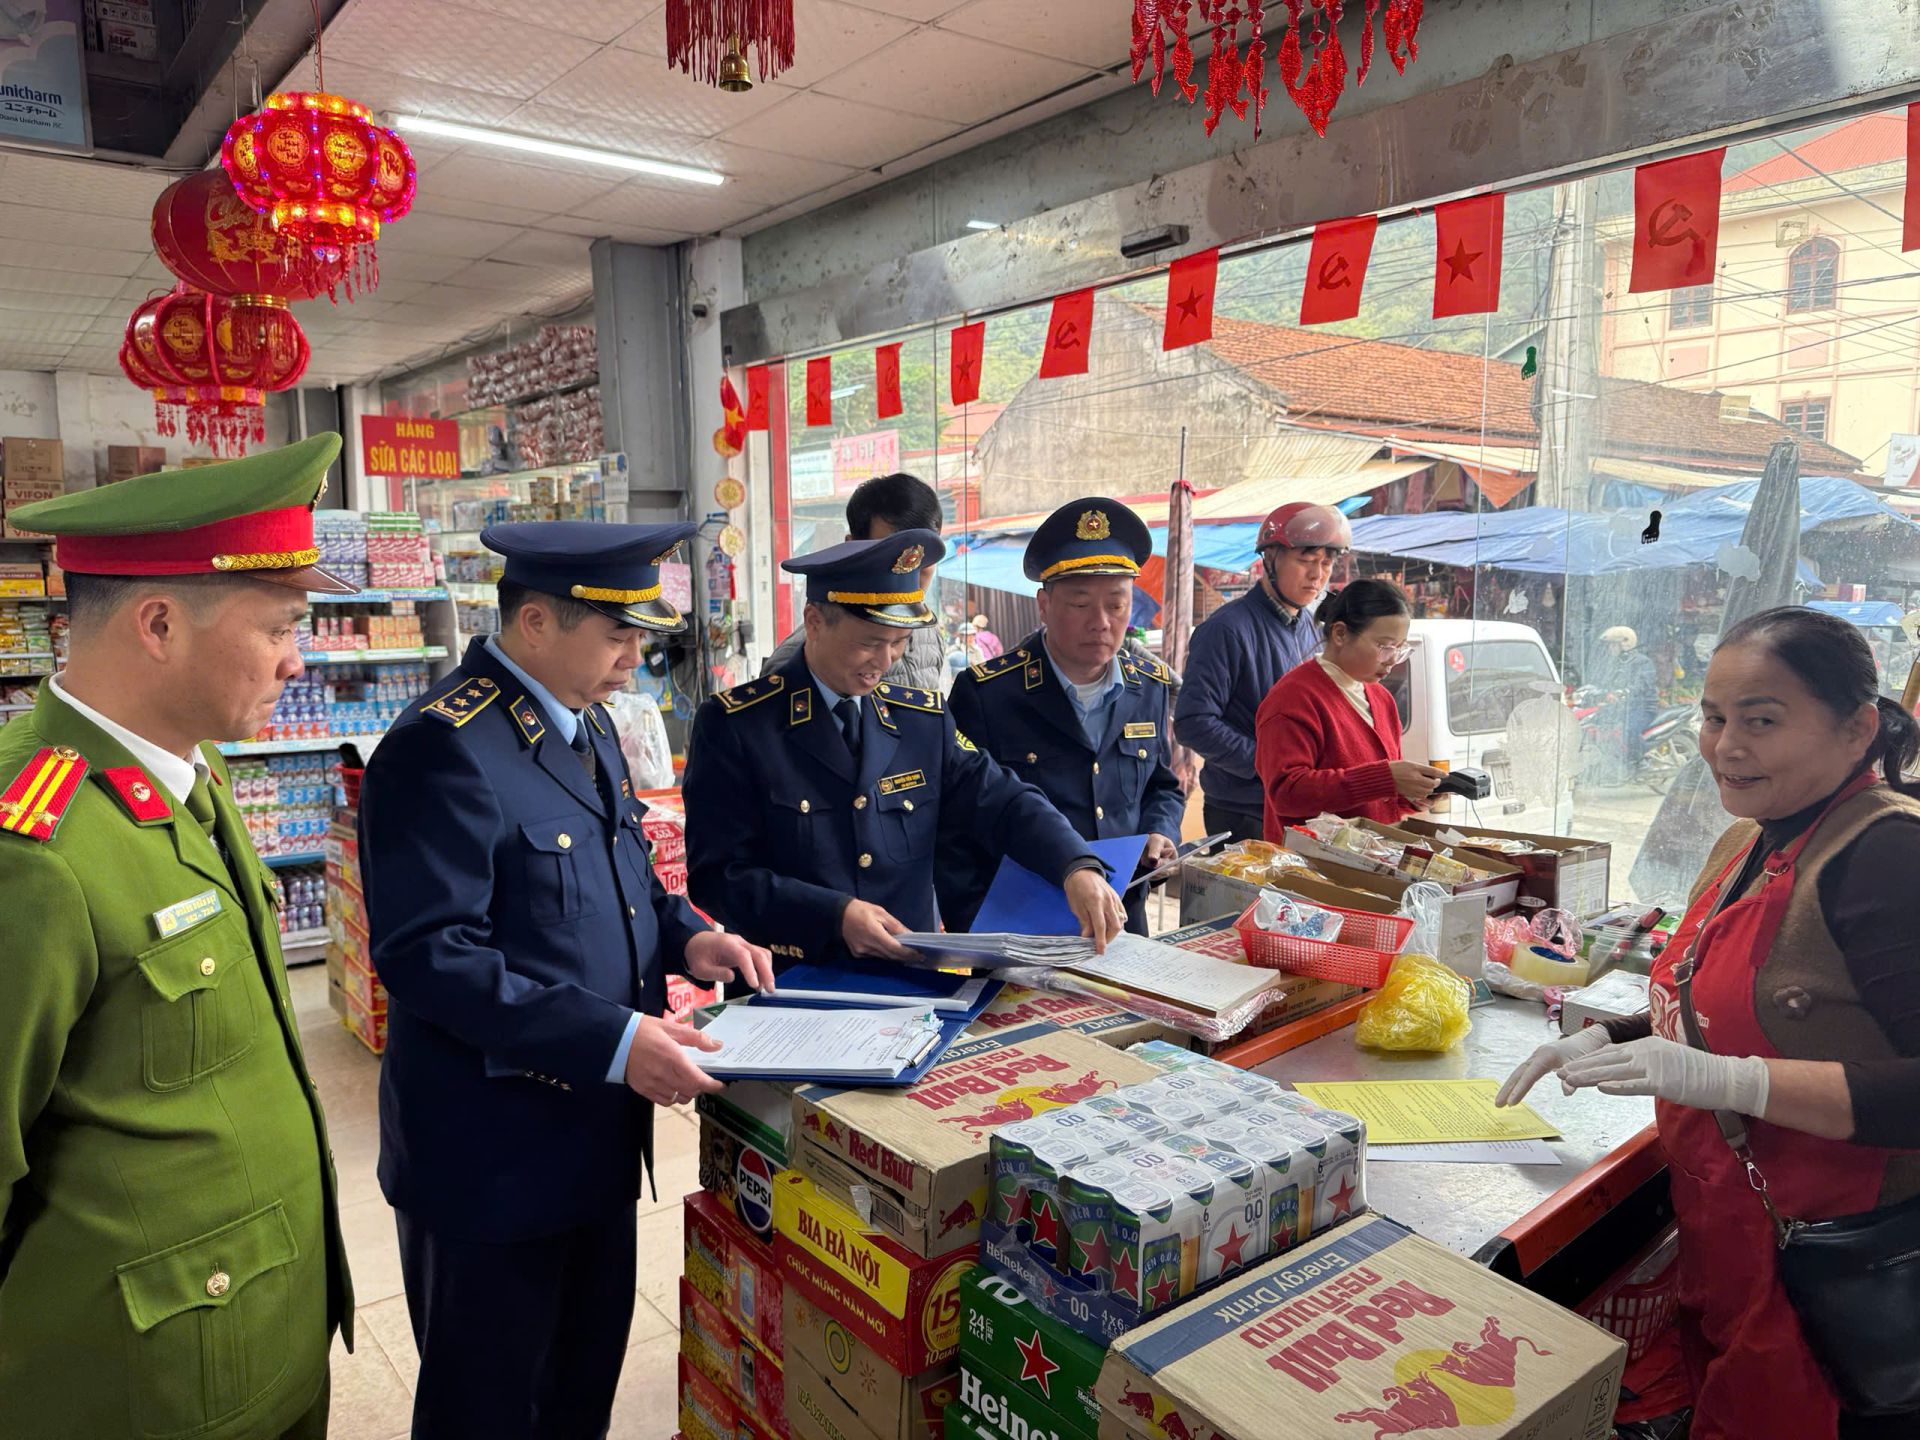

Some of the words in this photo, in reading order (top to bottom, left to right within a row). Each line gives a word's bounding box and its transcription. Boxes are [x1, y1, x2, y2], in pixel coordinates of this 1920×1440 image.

[19, 117, 51, 127] Unicharm
[429, 450, 458, 479] LOẠI
[15, 490, 53, 499] VIFON
[979, 1003, 1037, 1029] Red
[1089, 1016, 1130, 1031] Drink
[981, 1054, 1071, 1087] Red
[906, 1074, 1002, 1111] Bull
[849, 1128, 879, 1171] Red
[881, 1147, 914, 1191] Bull
[739, 1169, 771, 1209] PEPSI
[1203, 1208, 1210, 1223] 6
[1245, 1199, 1263, 1223] 0.0
[798, 1208, 823, 1248] BIA
[824, 1228, 849, 1267] HÀ
[850, 1244, 881, 1289] NỘI
[986, 1240, 1037, 1284] Heineken
[1274, 1252, 1350, 1293] Energy
[969, 1307, 985, 1332] 24
[1070, 1296, 1089, 1322] 0.0
[1214, 1286, 1284, 1325] Drink
[1344, 1280, 1457, 1345] Red
[969, 1324, 984, 1341] PACK
[1266, 1320, 1387, 1393] Bull
